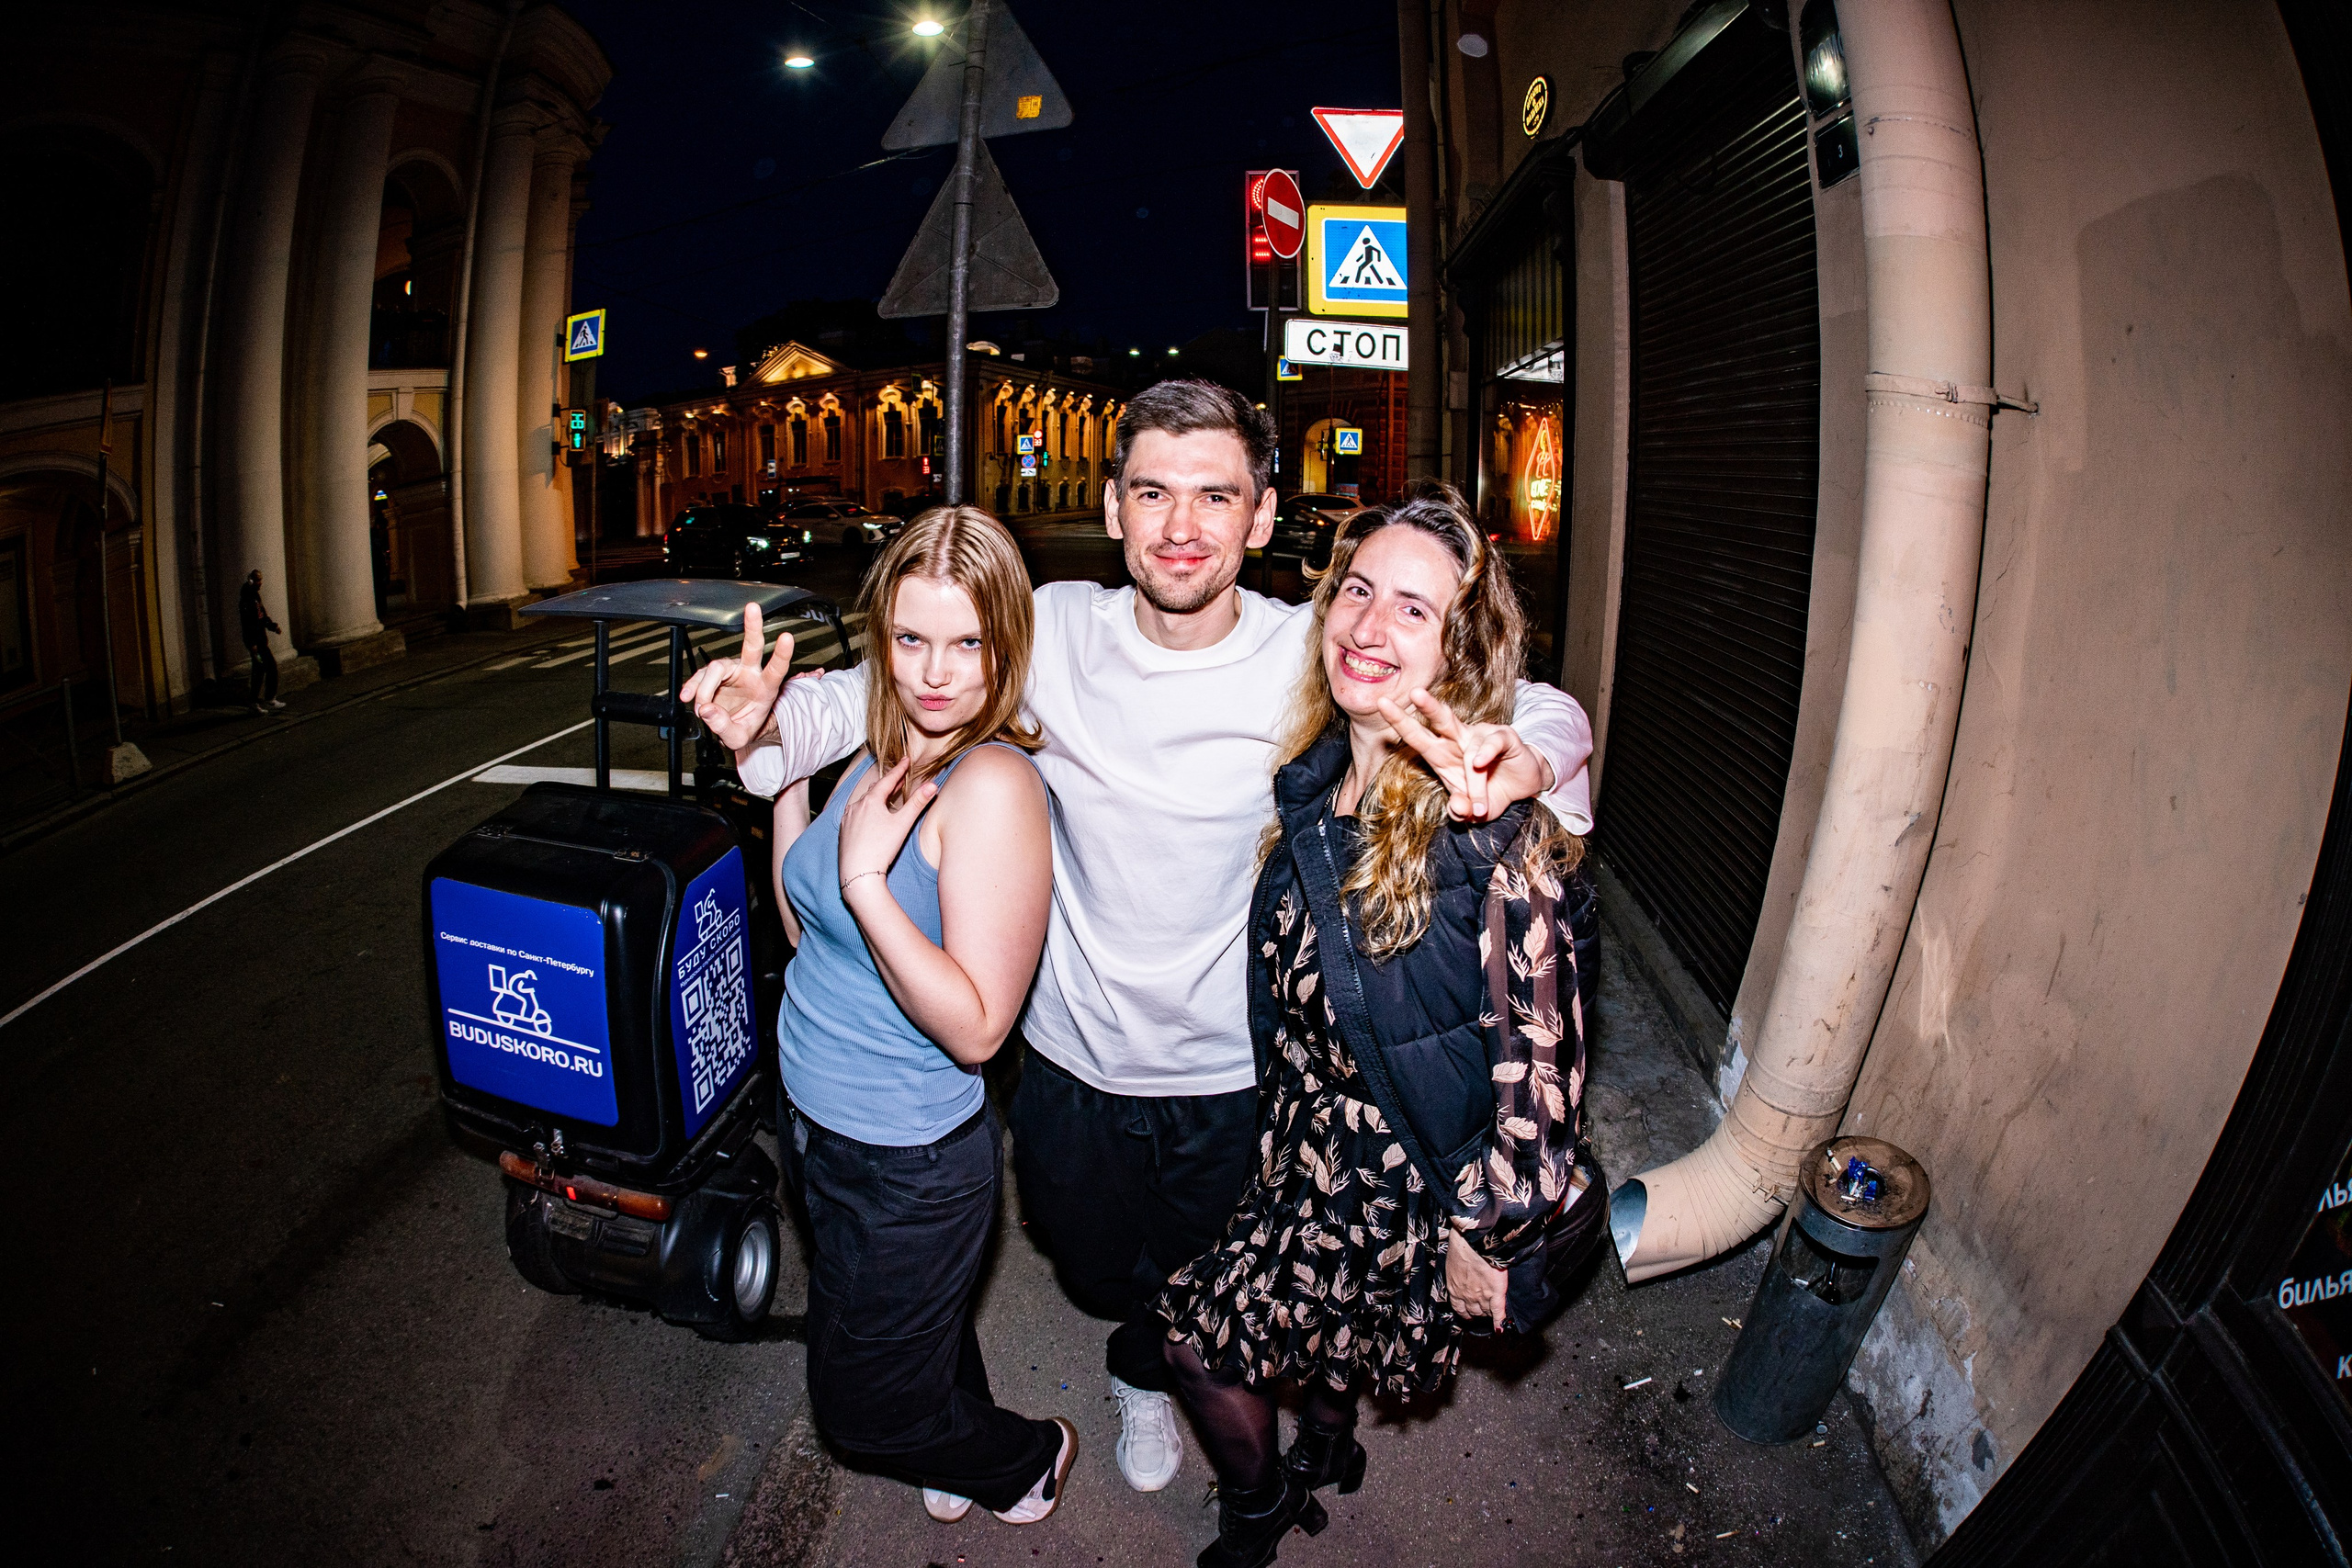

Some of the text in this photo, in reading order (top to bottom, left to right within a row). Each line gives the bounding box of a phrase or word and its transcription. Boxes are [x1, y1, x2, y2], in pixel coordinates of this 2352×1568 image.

[1306, 328, 1400, 362] СТОП
[440, 931, 594, 977] Сервис доставки по Санкт-Петербургу
[678, 915, 741, 979] БУДУ СКОРО
[449, 1021, 603, 1077] BUDUSKORO.RU
